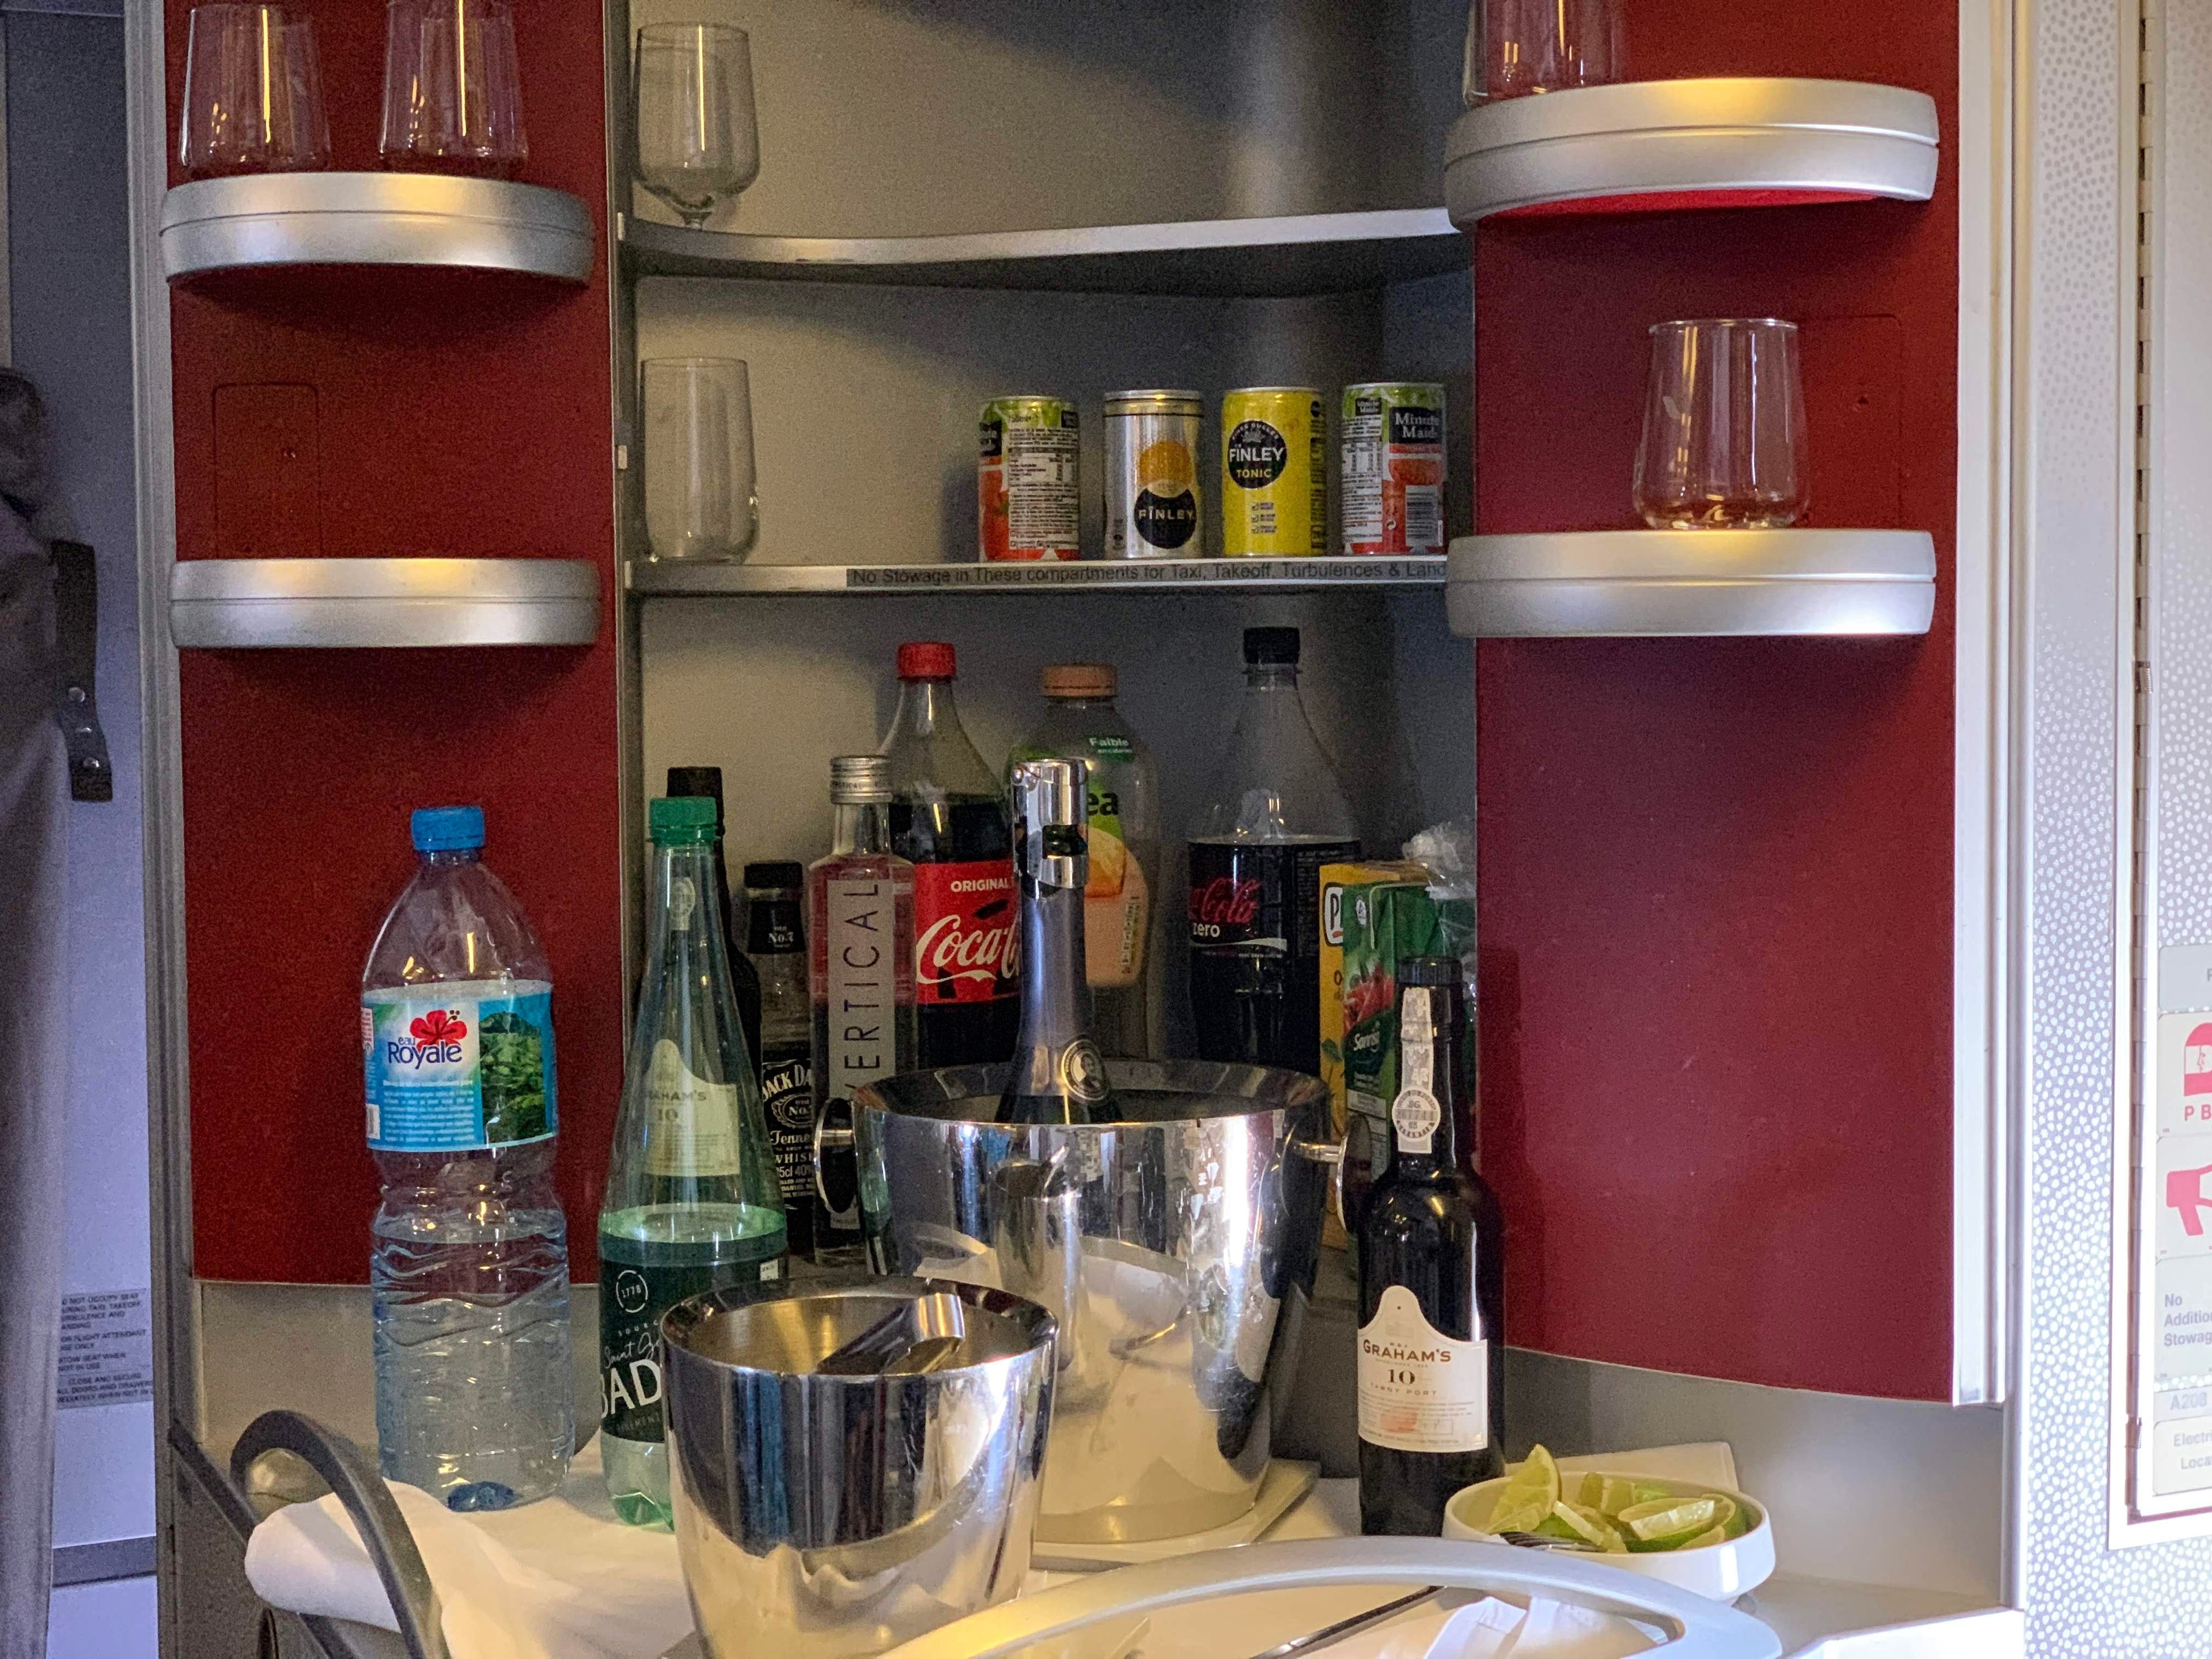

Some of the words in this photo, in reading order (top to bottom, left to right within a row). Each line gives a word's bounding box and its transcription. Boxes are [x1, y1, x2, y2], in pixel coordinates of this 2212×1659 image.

[1395, 412, 1439, 426] Minute
[1402, 426, 1435, 438] Maid
[1236, 469, 1272, 478] TONIC
[854, 569, 876, 584] No
[883, 568, 951, 586] Stowage
[956, 569, 969, 582] in
[976, 567, 1021, 582] These
[1027, 565, 1138, 584] compartments
[1143, 564, 1165, 579] for
[1283, 561, 1382, 577] Turbulences
[1389, 561, 1400, 577] &
[1089, 737, 1129, 747] Faible
[950, 878, 1008, 892] ORIGINAL
[398, 1036, 415, 1046] eau
[388, 1040, 463, 1070] Royale
[622, 1285, 642, 1298] 1778
[2164, 1294, 2183, 1307] No
[1363, 1339, 1452, 1362] GRAHAM'S
[1387, 1369, 1415, 1385] 10
